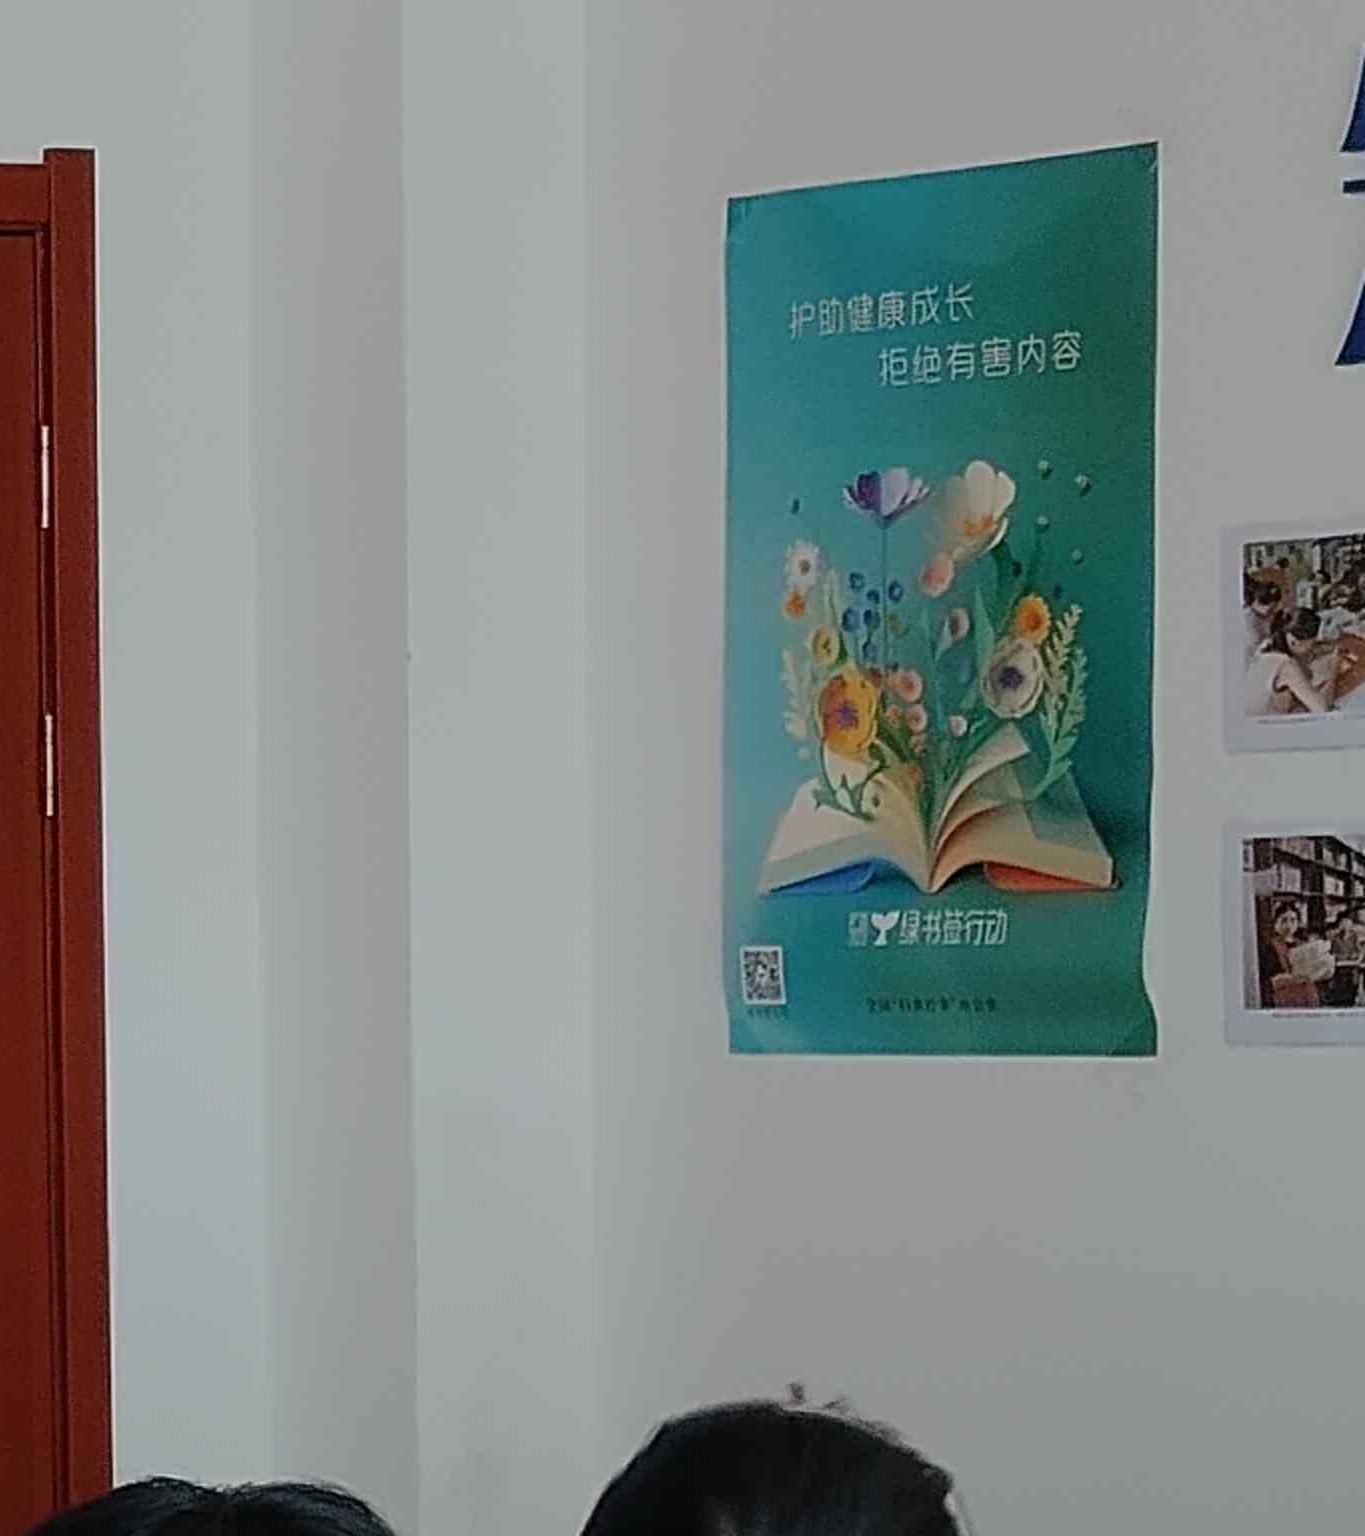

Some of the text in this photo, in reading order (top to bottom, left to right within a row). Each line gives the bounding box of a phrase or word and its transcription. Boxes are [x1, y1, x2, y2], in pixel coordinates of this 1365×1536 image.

[789, 283, 975, 341] 护助健康成长
[878, 329, 1083, 388] 拒绝有害内容
